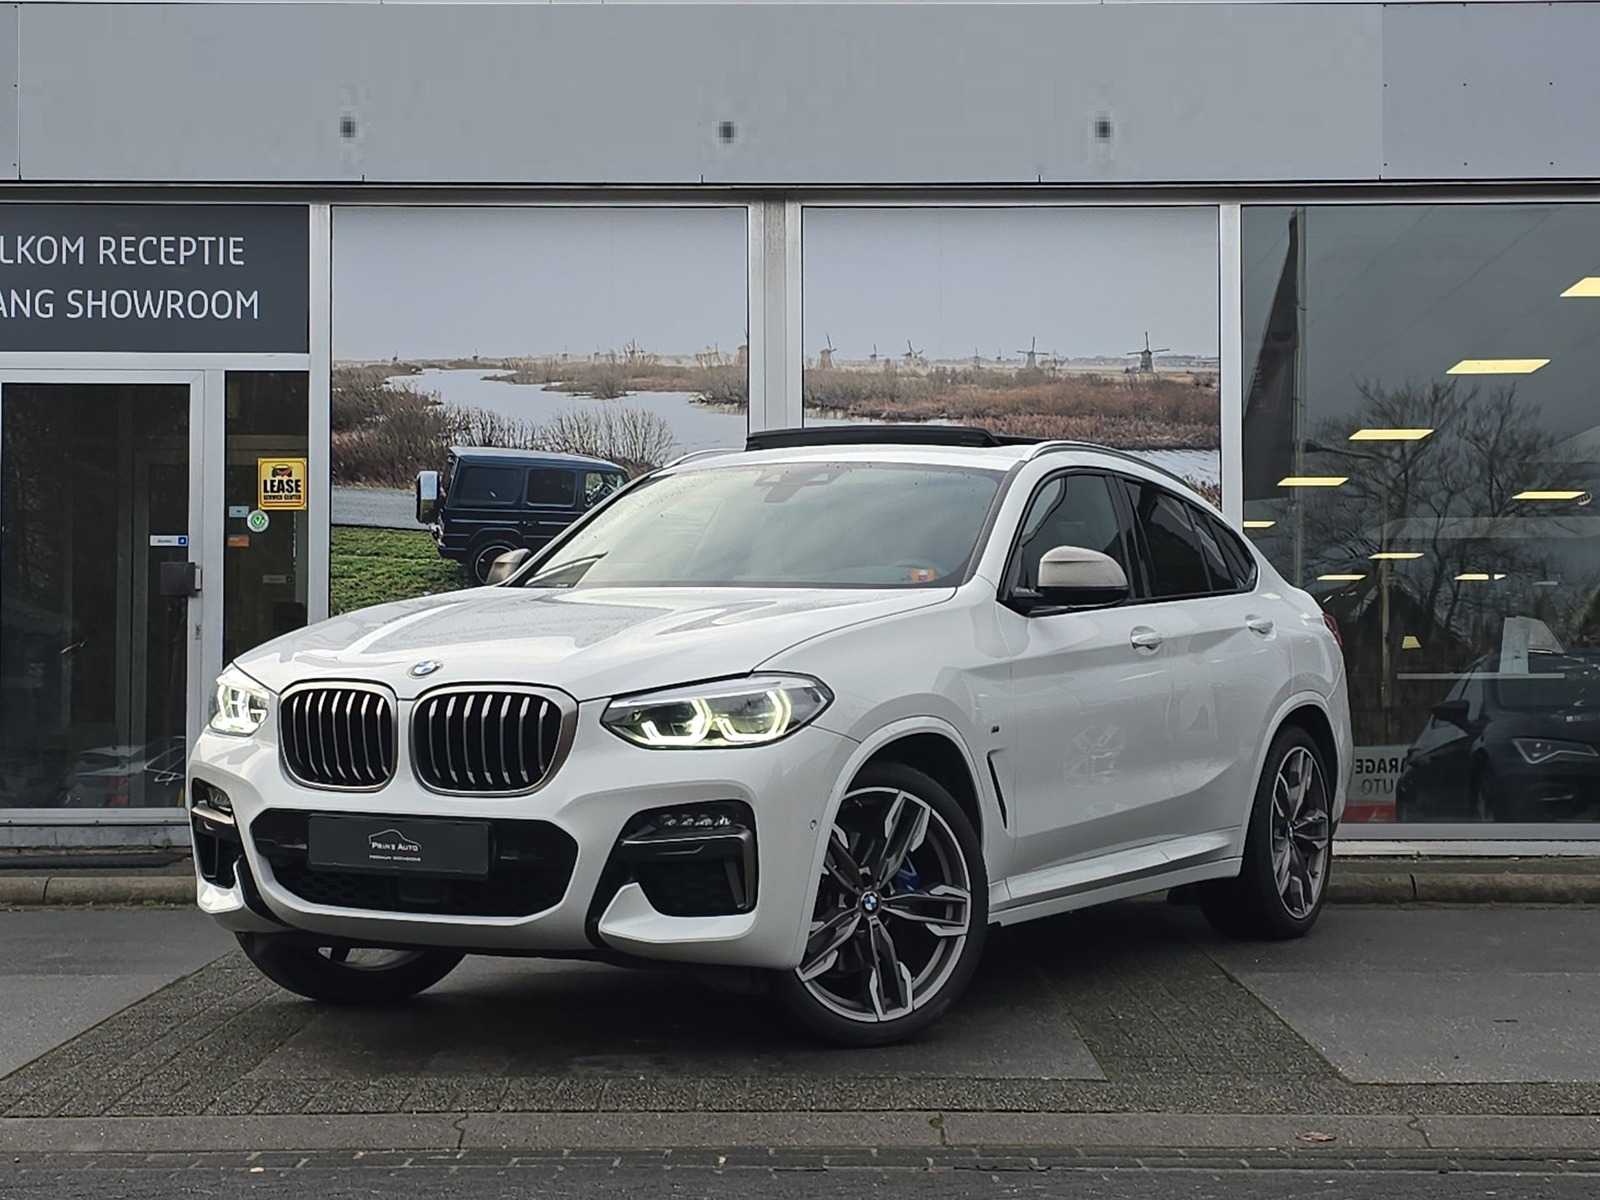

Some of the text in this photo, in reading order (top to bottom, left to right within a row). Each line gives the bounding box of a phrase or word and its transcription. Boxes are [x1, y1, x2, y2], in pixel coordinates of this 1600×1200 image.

[99, 236, 245, 266] RECEPTIE
[66, 289, 259, 320] SHOWROOM
[263, 479, 302, 494] LEASE
